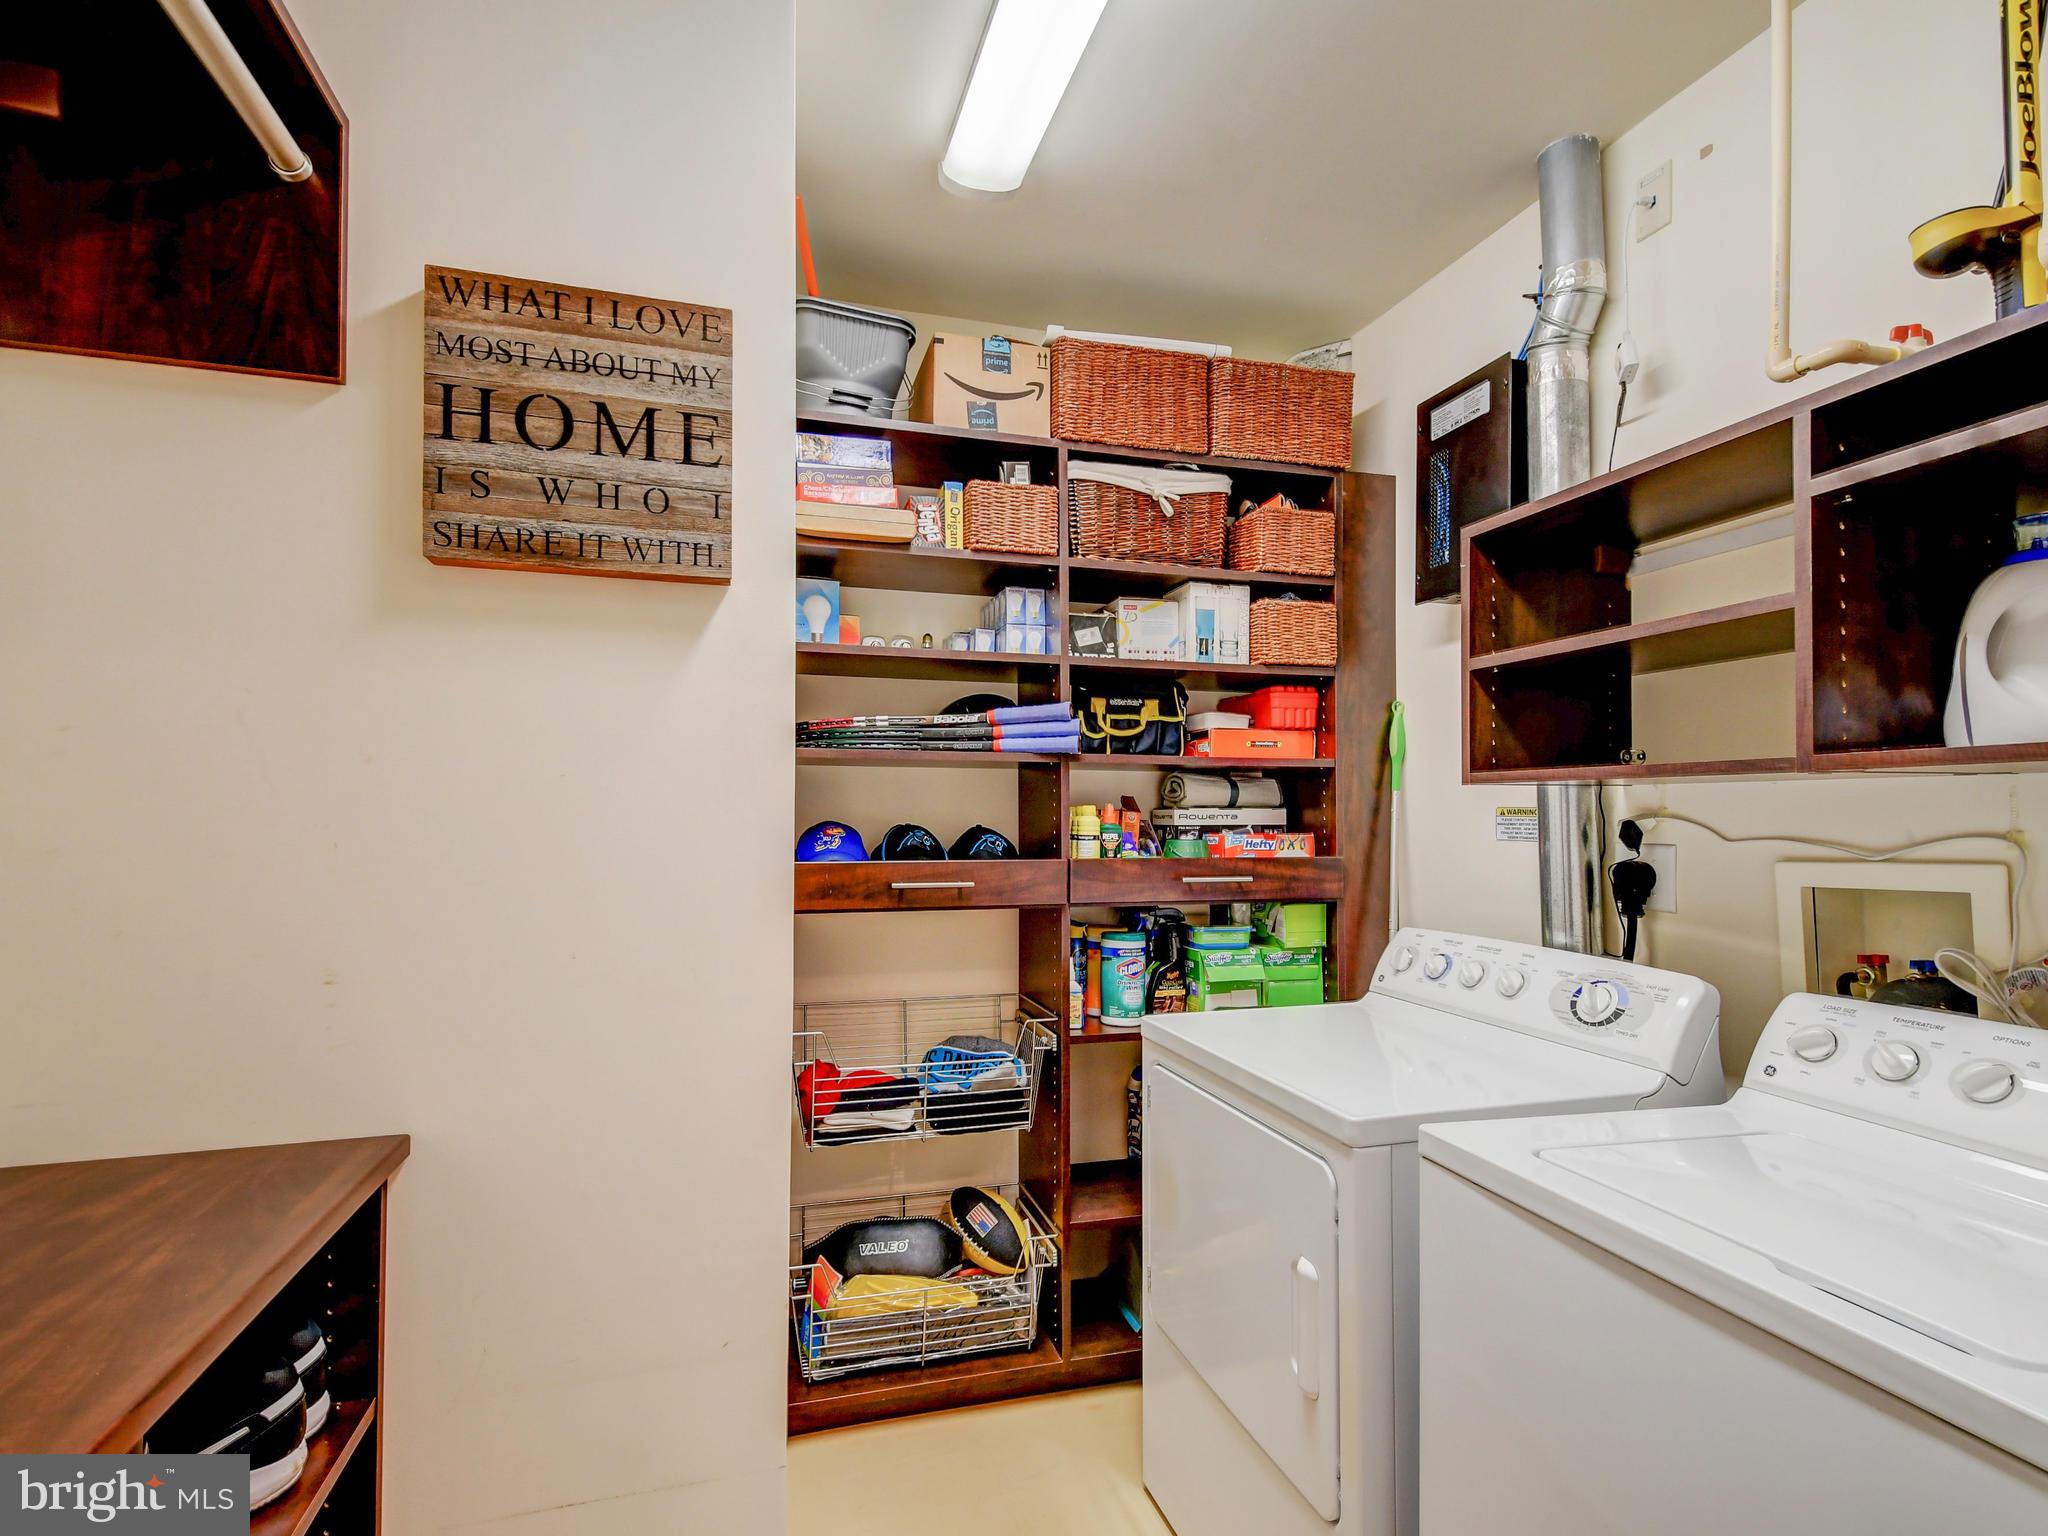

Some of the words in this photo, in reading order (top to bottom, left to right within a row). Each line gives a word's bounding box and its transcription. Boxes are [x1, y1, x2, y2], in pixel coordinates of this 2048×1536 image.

[438, 275, 571, 321] WHAT
[584, 296, 594, 325] I
[608, 300, 723, 344] LOVE
[436, 330, 536, 366] MOST
[544, 346, 662, 383] ABOUT
[671, 361, 722, 389] MY
[985, 357, 1009, 367] prime
[434, 381, 723, 469] HOME
[971, 416, 995, 426] prime
[433, 466, 491, 499] IS
[536, 476, 670, 514] WHO
[712, 494, 722, 519] I
[918, 504, 941, 543] Jenga
[433, 521, 564, 556] SHARE
[578, 532, 611, 559] IT
[622, 536, 722, 568] WITH.
[934, 714, 980, 724] Babolat
[1244, 839, 1276, 851] Hefty
[1266, 951, 1293, 963] Swiffer
[1823, 1003, 1841, 1012] LOAD
[1892, 1016, 1946, 1031] TEMPERATURE
[1992, 1035, 2032, 1047] OPTIONS
[859, 1240, 909, 1256] VALEO
